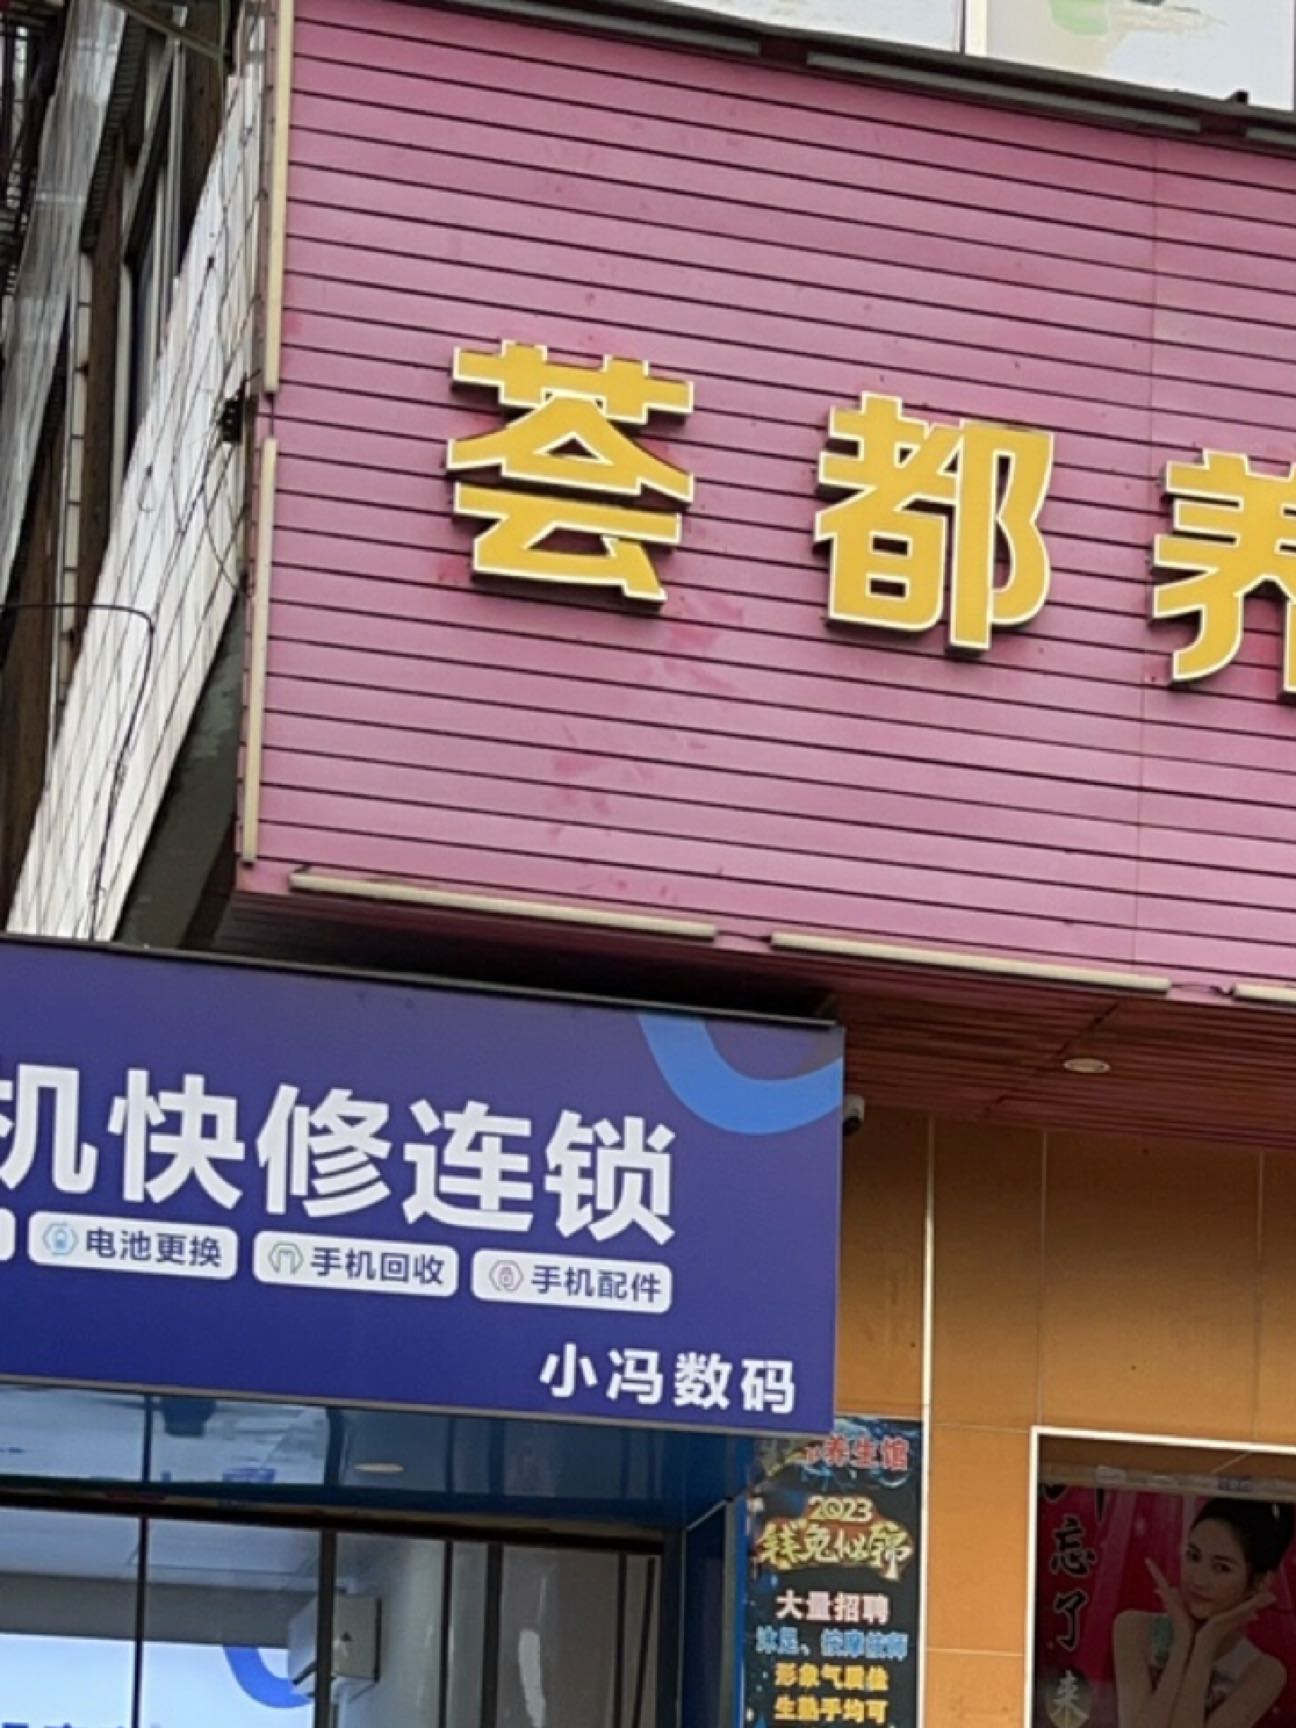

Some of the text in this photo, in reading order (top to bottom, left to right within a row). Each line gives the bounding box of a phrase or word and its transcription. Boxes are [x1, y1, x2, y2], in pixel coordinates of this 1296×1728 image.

[0, 1064, 676, 1245] 机快修连锁
[85, 1227, 662, 1304] 电池更换 手机回收 手机配件
[539, 1343, 796, 1414] 小冯数码
[807, 1495, 873, 1522] 2023
[776, 1590, 890, 1625] 大量招聘
